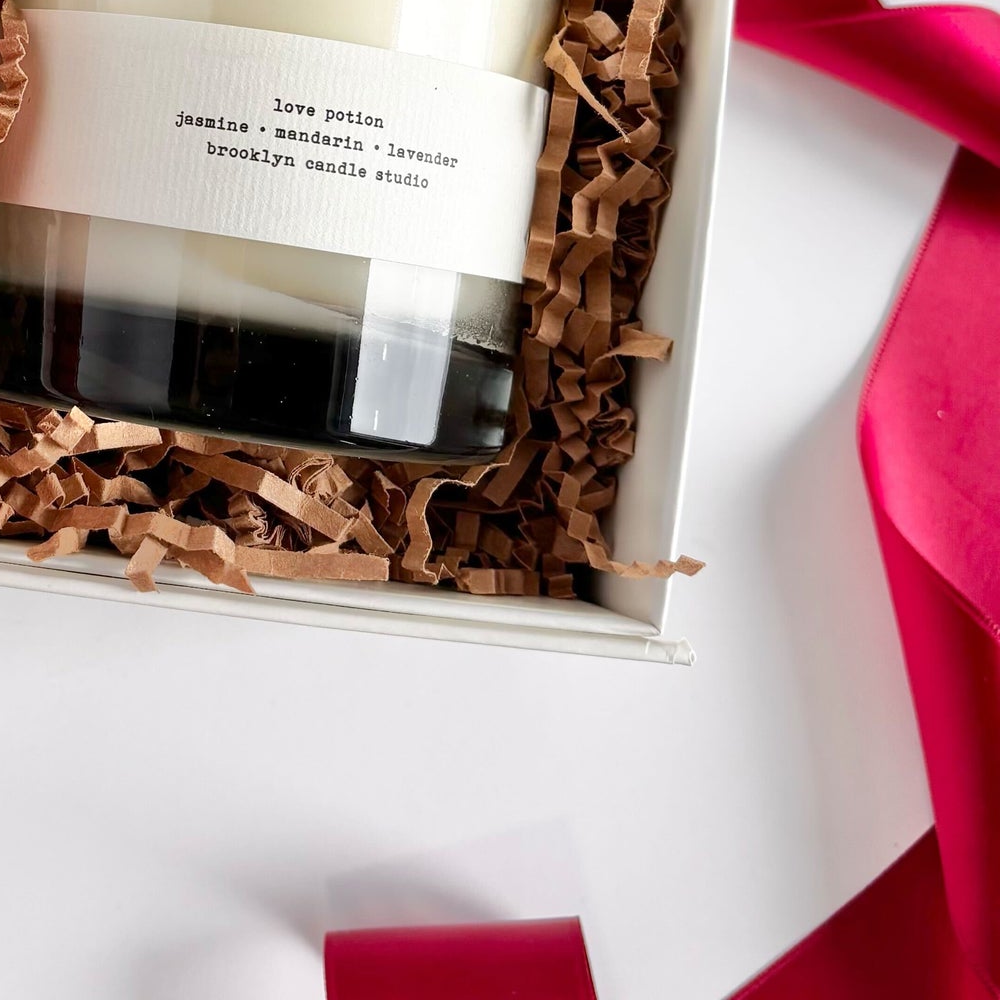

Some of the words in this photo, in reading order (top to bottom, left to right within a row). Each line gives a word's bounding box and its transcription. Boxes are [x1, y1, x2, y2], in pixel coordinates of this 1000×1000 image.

[273, 97, 316, 118] love
[325, 107, 385, 130] potion
[175, 110, 250, 134] jasmine
[274, 126, 364, 152] mandarin
[387, 143, 459, 169] lavender
[206, 141, 296, 168] brooklyn
[305, 157, 367, 179] candle
[375, 166, 430, 189] studio
